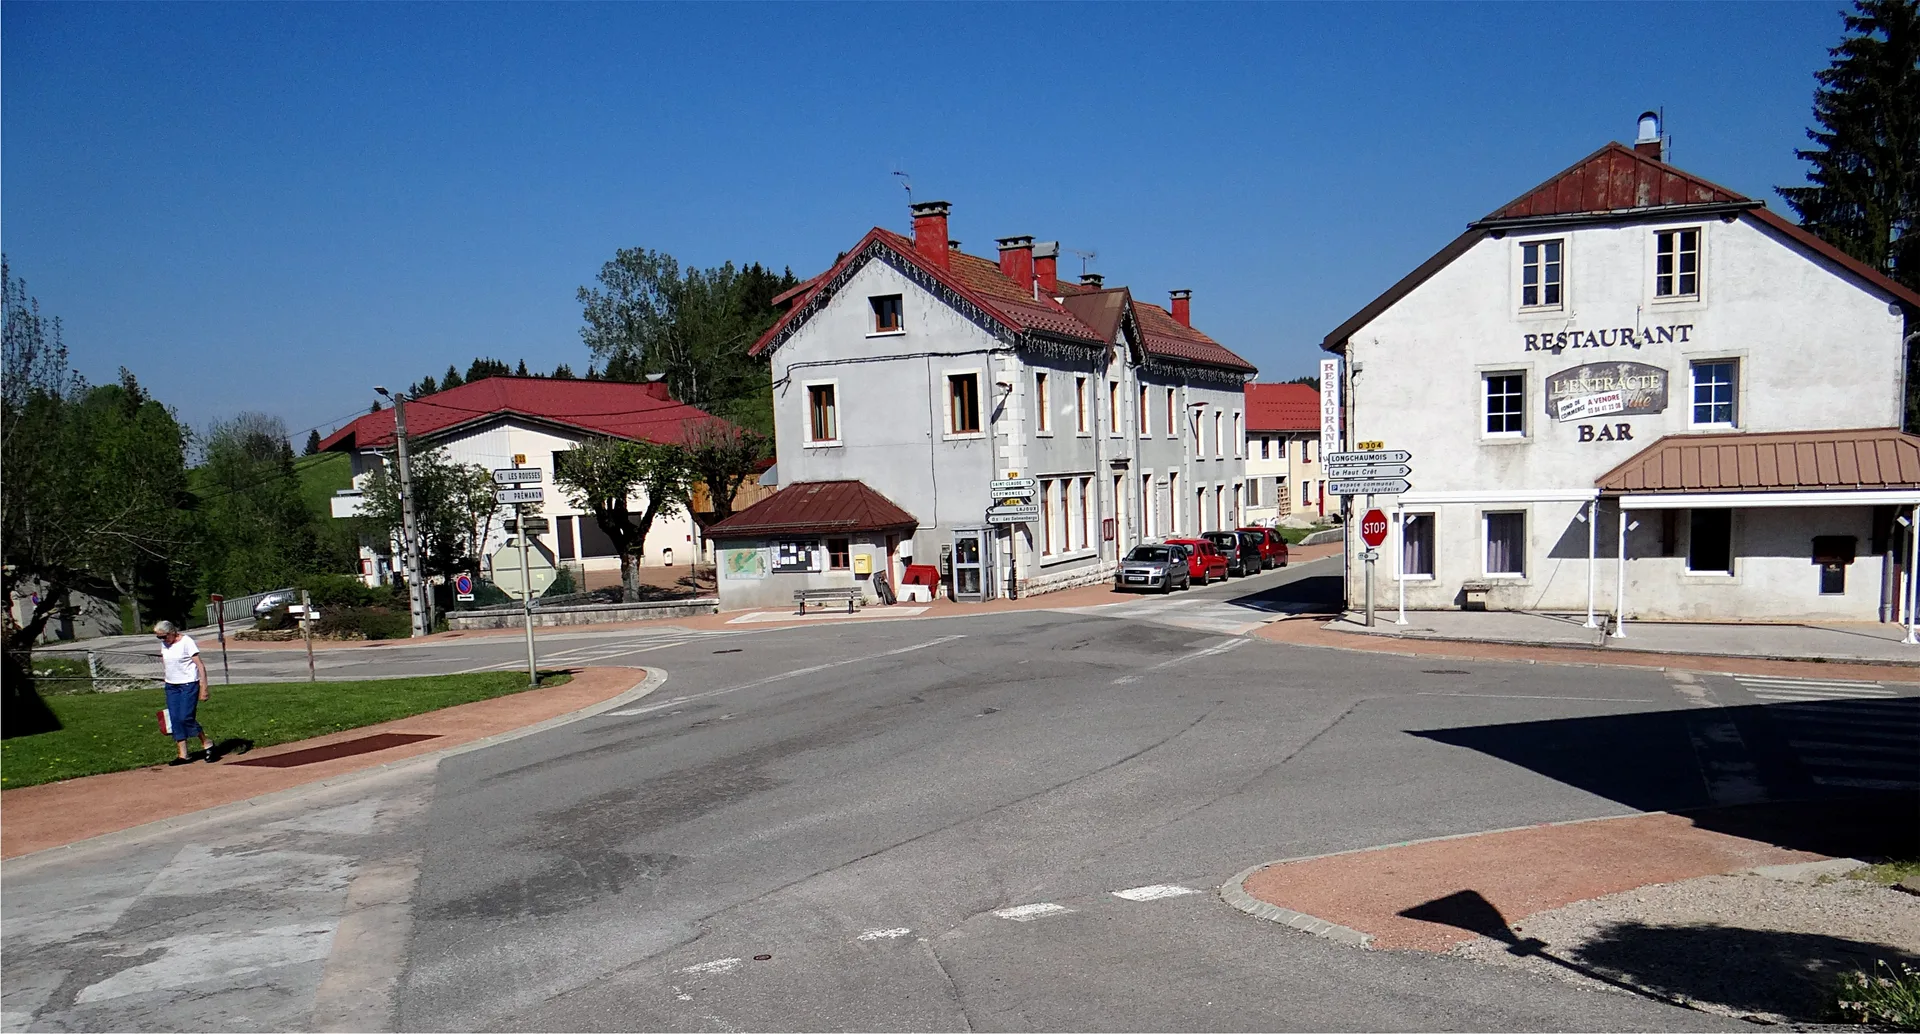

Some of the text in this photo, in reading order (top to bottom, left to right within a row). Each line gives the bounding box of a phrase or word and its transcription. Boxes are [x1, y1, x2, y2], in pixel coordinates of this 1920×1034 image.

[1524, 324, 1693, 352] RESTAURANT
[1553, 375, 1661, 394] L'ENTRACTE
[1594, 394, 1620, 404] VENDRE
[1324, 363, 1335, 450] RESTAURANT
[1561, 403, 1573, 412] FOND
[1561, 404, 1586, 419] COMMERCE
[1578, 423, 1633, 442] BAR
[508, 472, 517, 480] LES
[519, 471, 540, 479] ROUSSES
[514, 491, 542, 499] PRÉMANON
[1364, 521, 1386, 535] STOP
